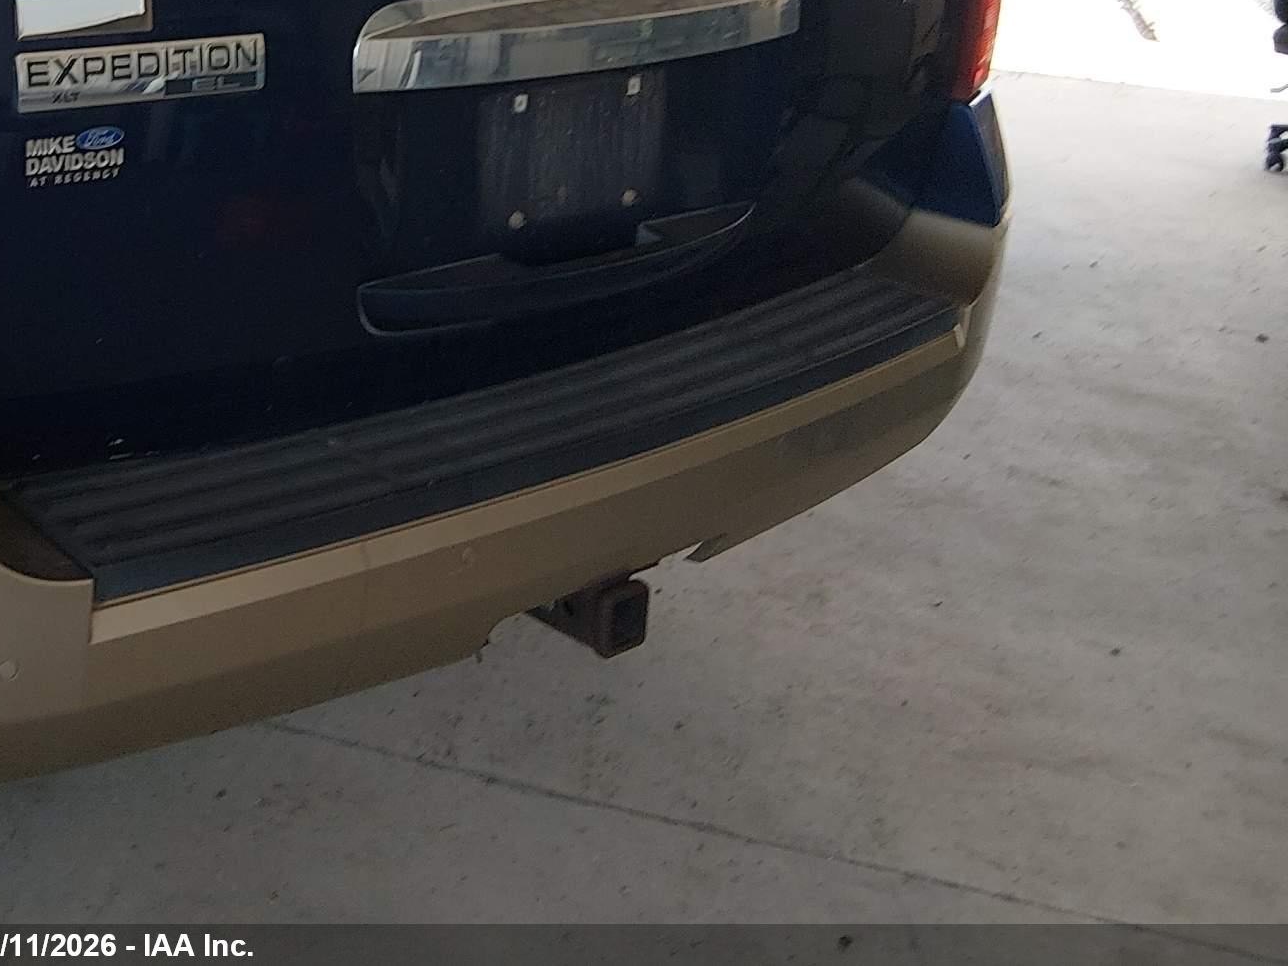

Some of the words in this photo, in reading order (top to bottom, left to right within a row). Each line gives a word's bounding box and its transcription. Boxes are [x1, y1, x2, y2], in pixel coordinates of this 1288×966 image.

[26, 38, 259, 87] EXPEDITION
[25, 135, 76, 157] MIKE
[25, 148, 125, 176] DAVIDSON
[29, 176, 47, 187] AT
[54, 167, 120, 185] REGENCY
